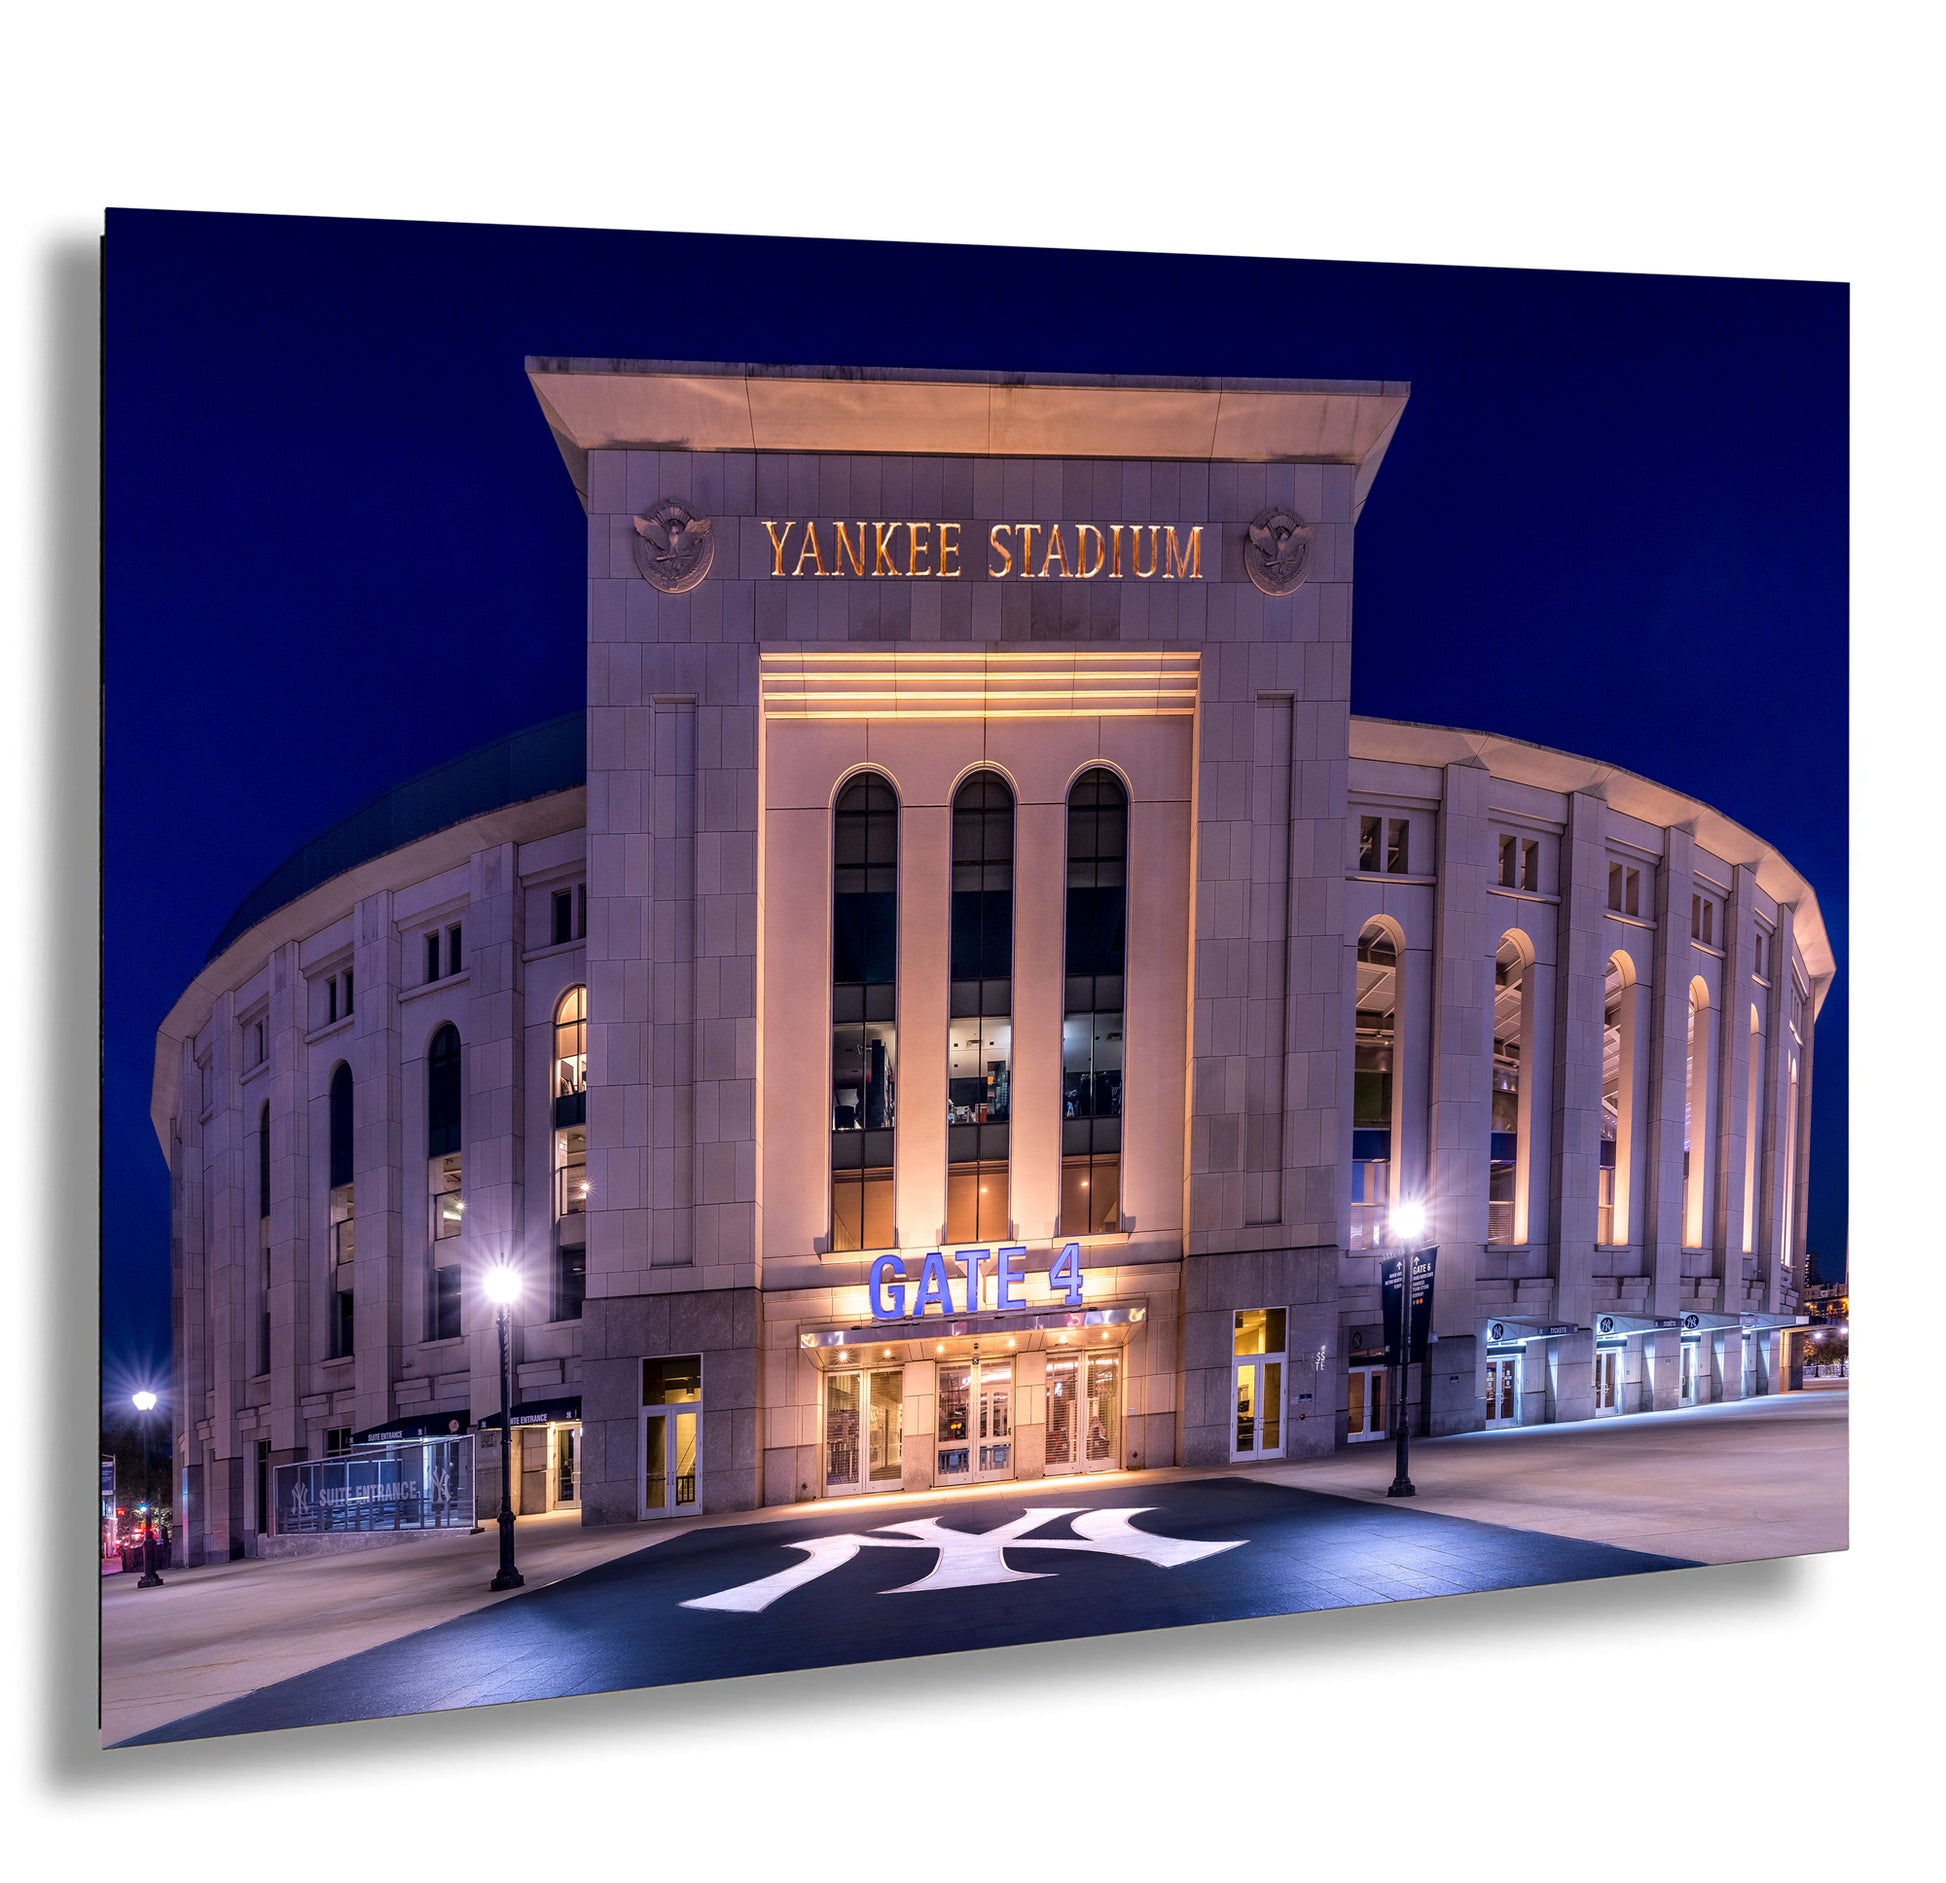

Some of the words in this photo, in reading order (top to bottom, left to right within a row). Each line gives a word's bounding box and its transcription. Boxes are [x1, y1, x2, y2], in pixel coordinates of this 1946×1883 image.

[761, 520, 961, 577] YANKEE
[988, 523, 1204, 579] STADIUM
[1413, 1263, 1427, 1275] GATE
[869, 1246, 1027, 1320] GATE
[1049, 1242, 1084, 1306] 4
[1550, 1326, 1567, 1334] TICKETS
[520, 1413, 548, 1424] ENTRANCE
[380, 1430, 403, 1441] ENTRANCE
[319, 1486, 352, 1507] SUITE
[355, 1480, 417, 1504] ENTRANCE
